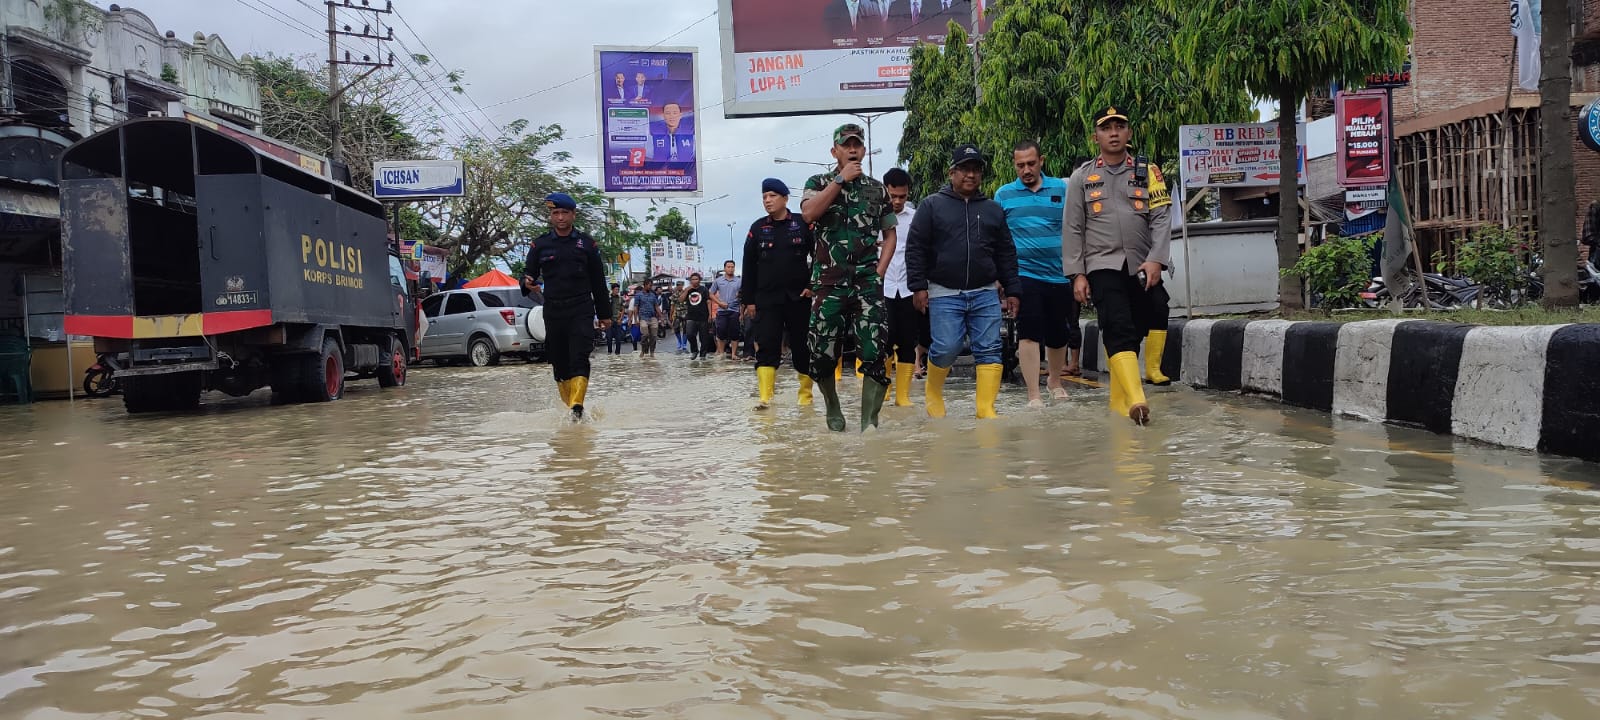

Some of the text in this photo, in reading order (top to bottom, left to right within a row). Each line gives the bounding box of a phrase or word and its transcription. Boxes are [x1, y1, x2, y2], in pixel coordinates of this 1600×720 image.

[748, 53, 804, 73] JANGAN
[750, 75, 786, 94] LUPA
[1345, 123, 1381, 131] KUALITAS
[1351, 116, 1375, 125] PILIH
[1213, 128, 1234, 140] HB
[1350, 129, 1377, 137] MERAH
[633, 150, 642, 164] 2
[1187, 155, 1233, 172] PEMILU
[383, 169, 420, 185] ICHSAN
[301, 234, 363, 274] POLISI
[304, 268, 363, 289] KORPS BRIMOB
